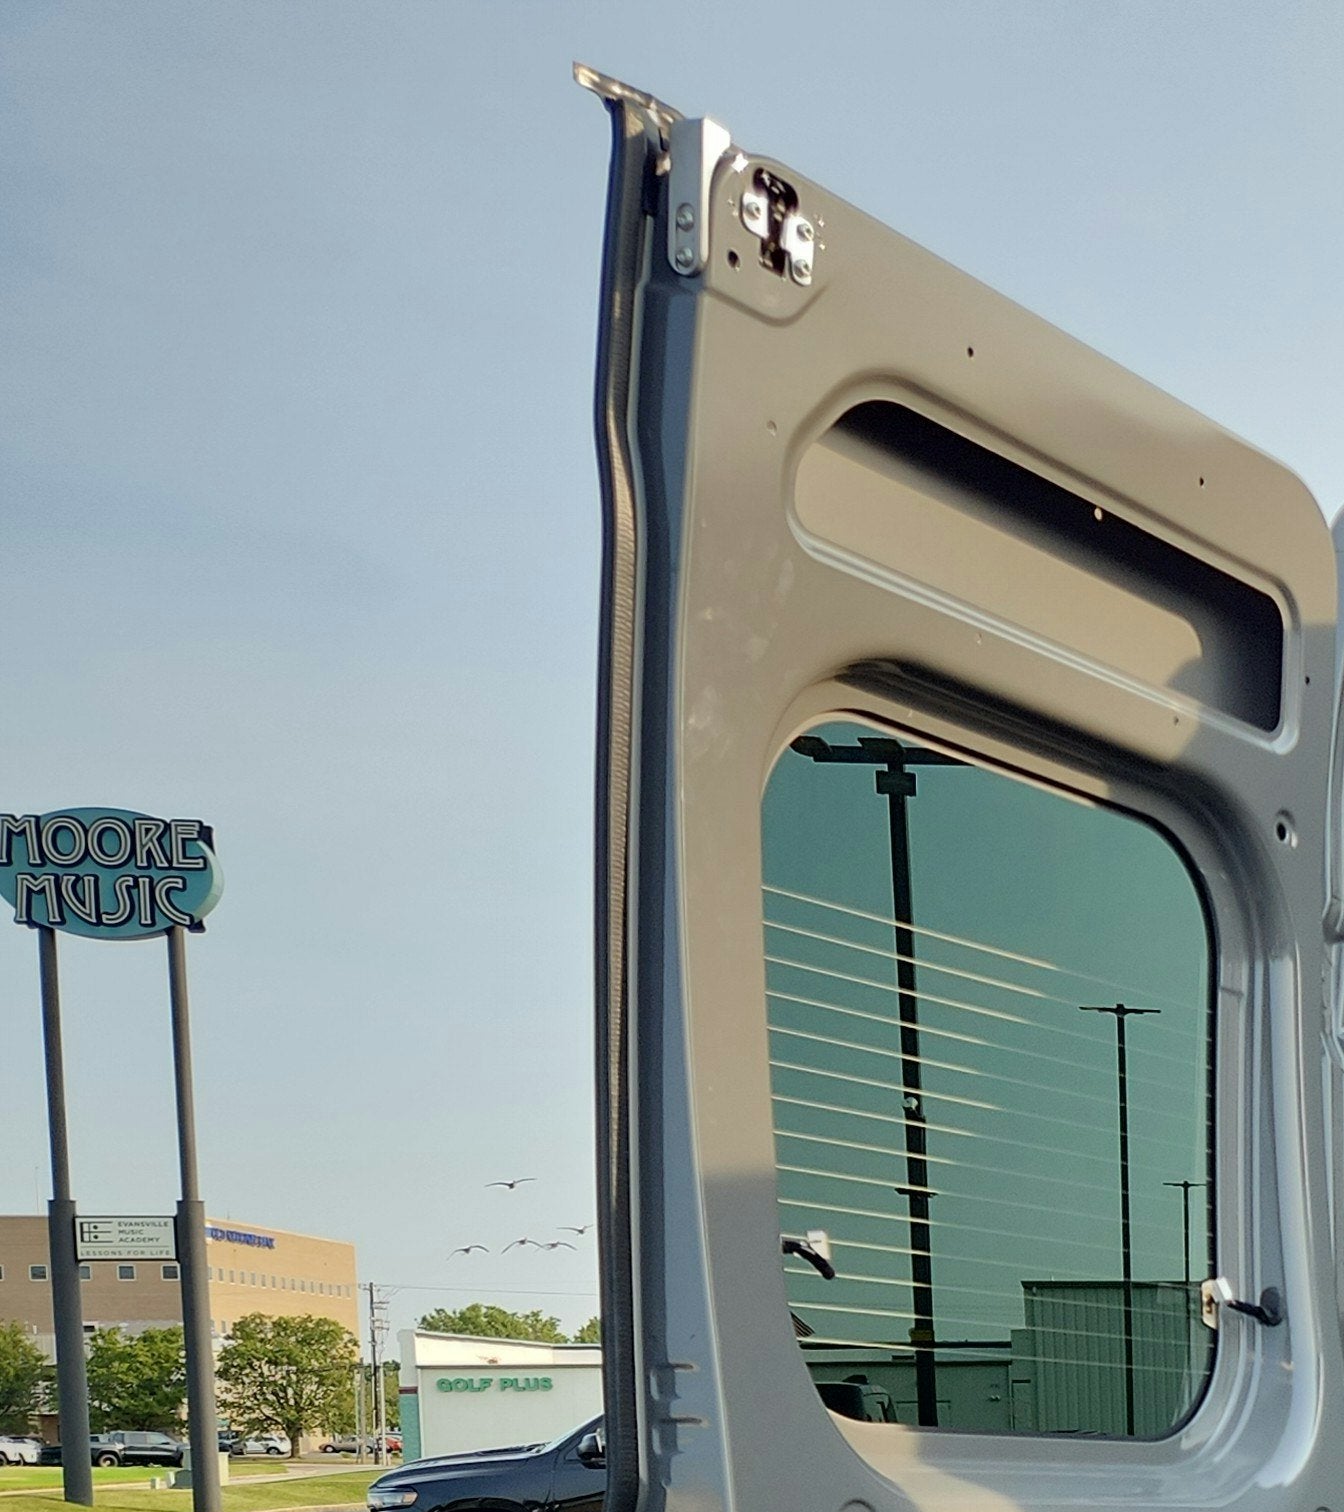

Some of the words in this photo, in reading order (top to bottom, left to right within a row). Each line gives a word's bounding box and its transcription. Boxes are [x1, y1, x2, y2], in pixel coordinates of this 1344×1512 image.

[0, 814, 206, 869] MOORE
[14, 872, 193, 926] MUSIC
[436, 1378, 494, 1393] GOLF
[500, 1377, 554, 1392] PLUS
